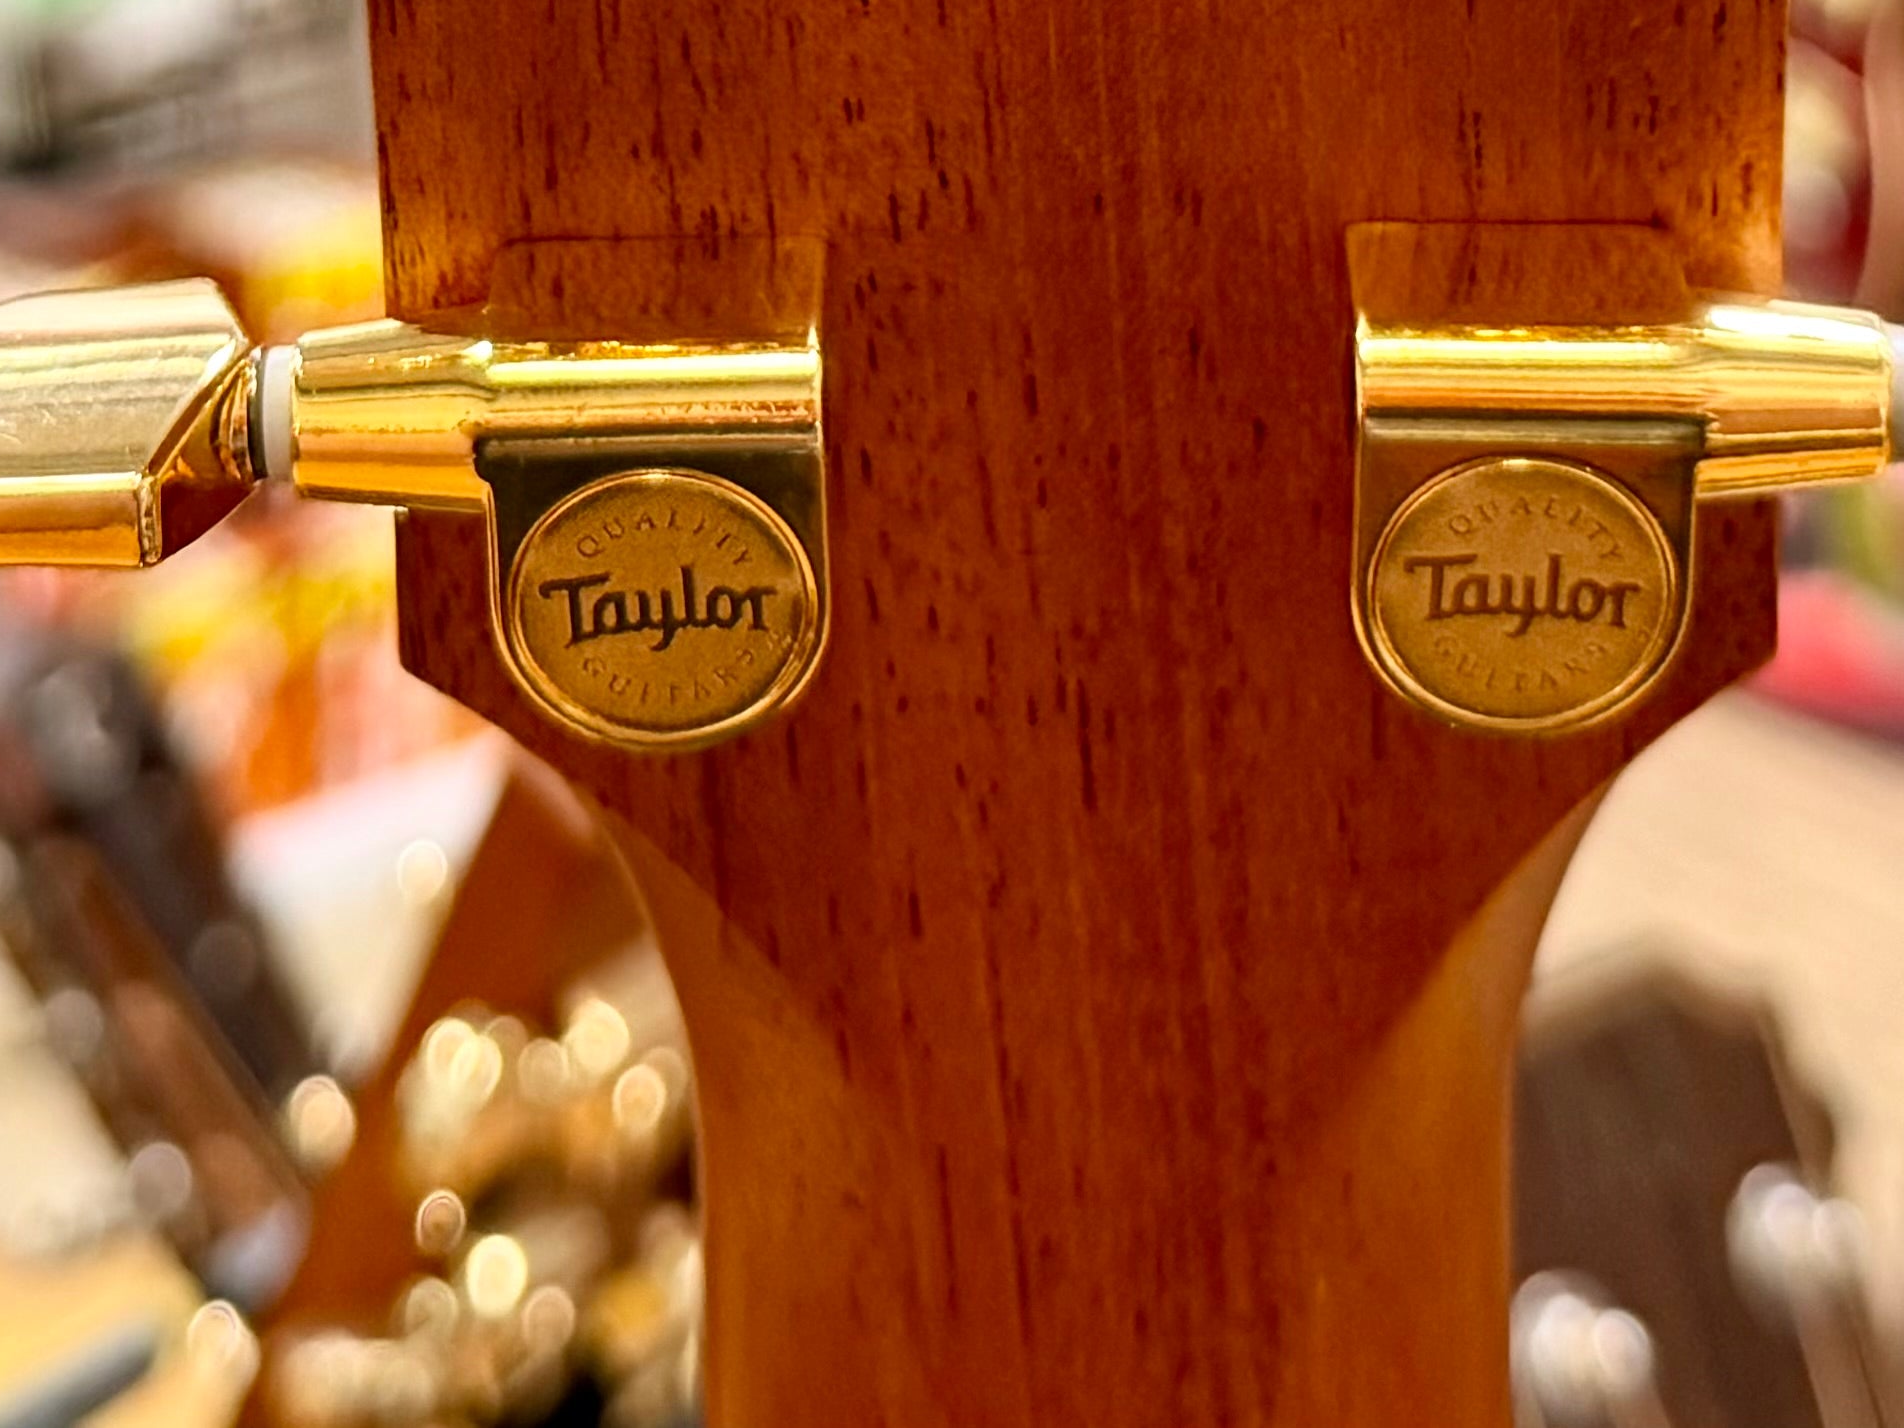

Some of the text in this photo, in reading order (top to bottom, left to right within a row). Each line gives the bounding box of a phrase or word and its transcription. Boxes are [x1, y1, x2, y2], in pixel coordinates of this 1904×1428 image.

[576, 507, 752, 565] QUALITY
[1449, 496, 1624, 561] QUALITY
[538, 564, 777, 652] Taylor
[1403, 553, 1642, 638] Taylor
